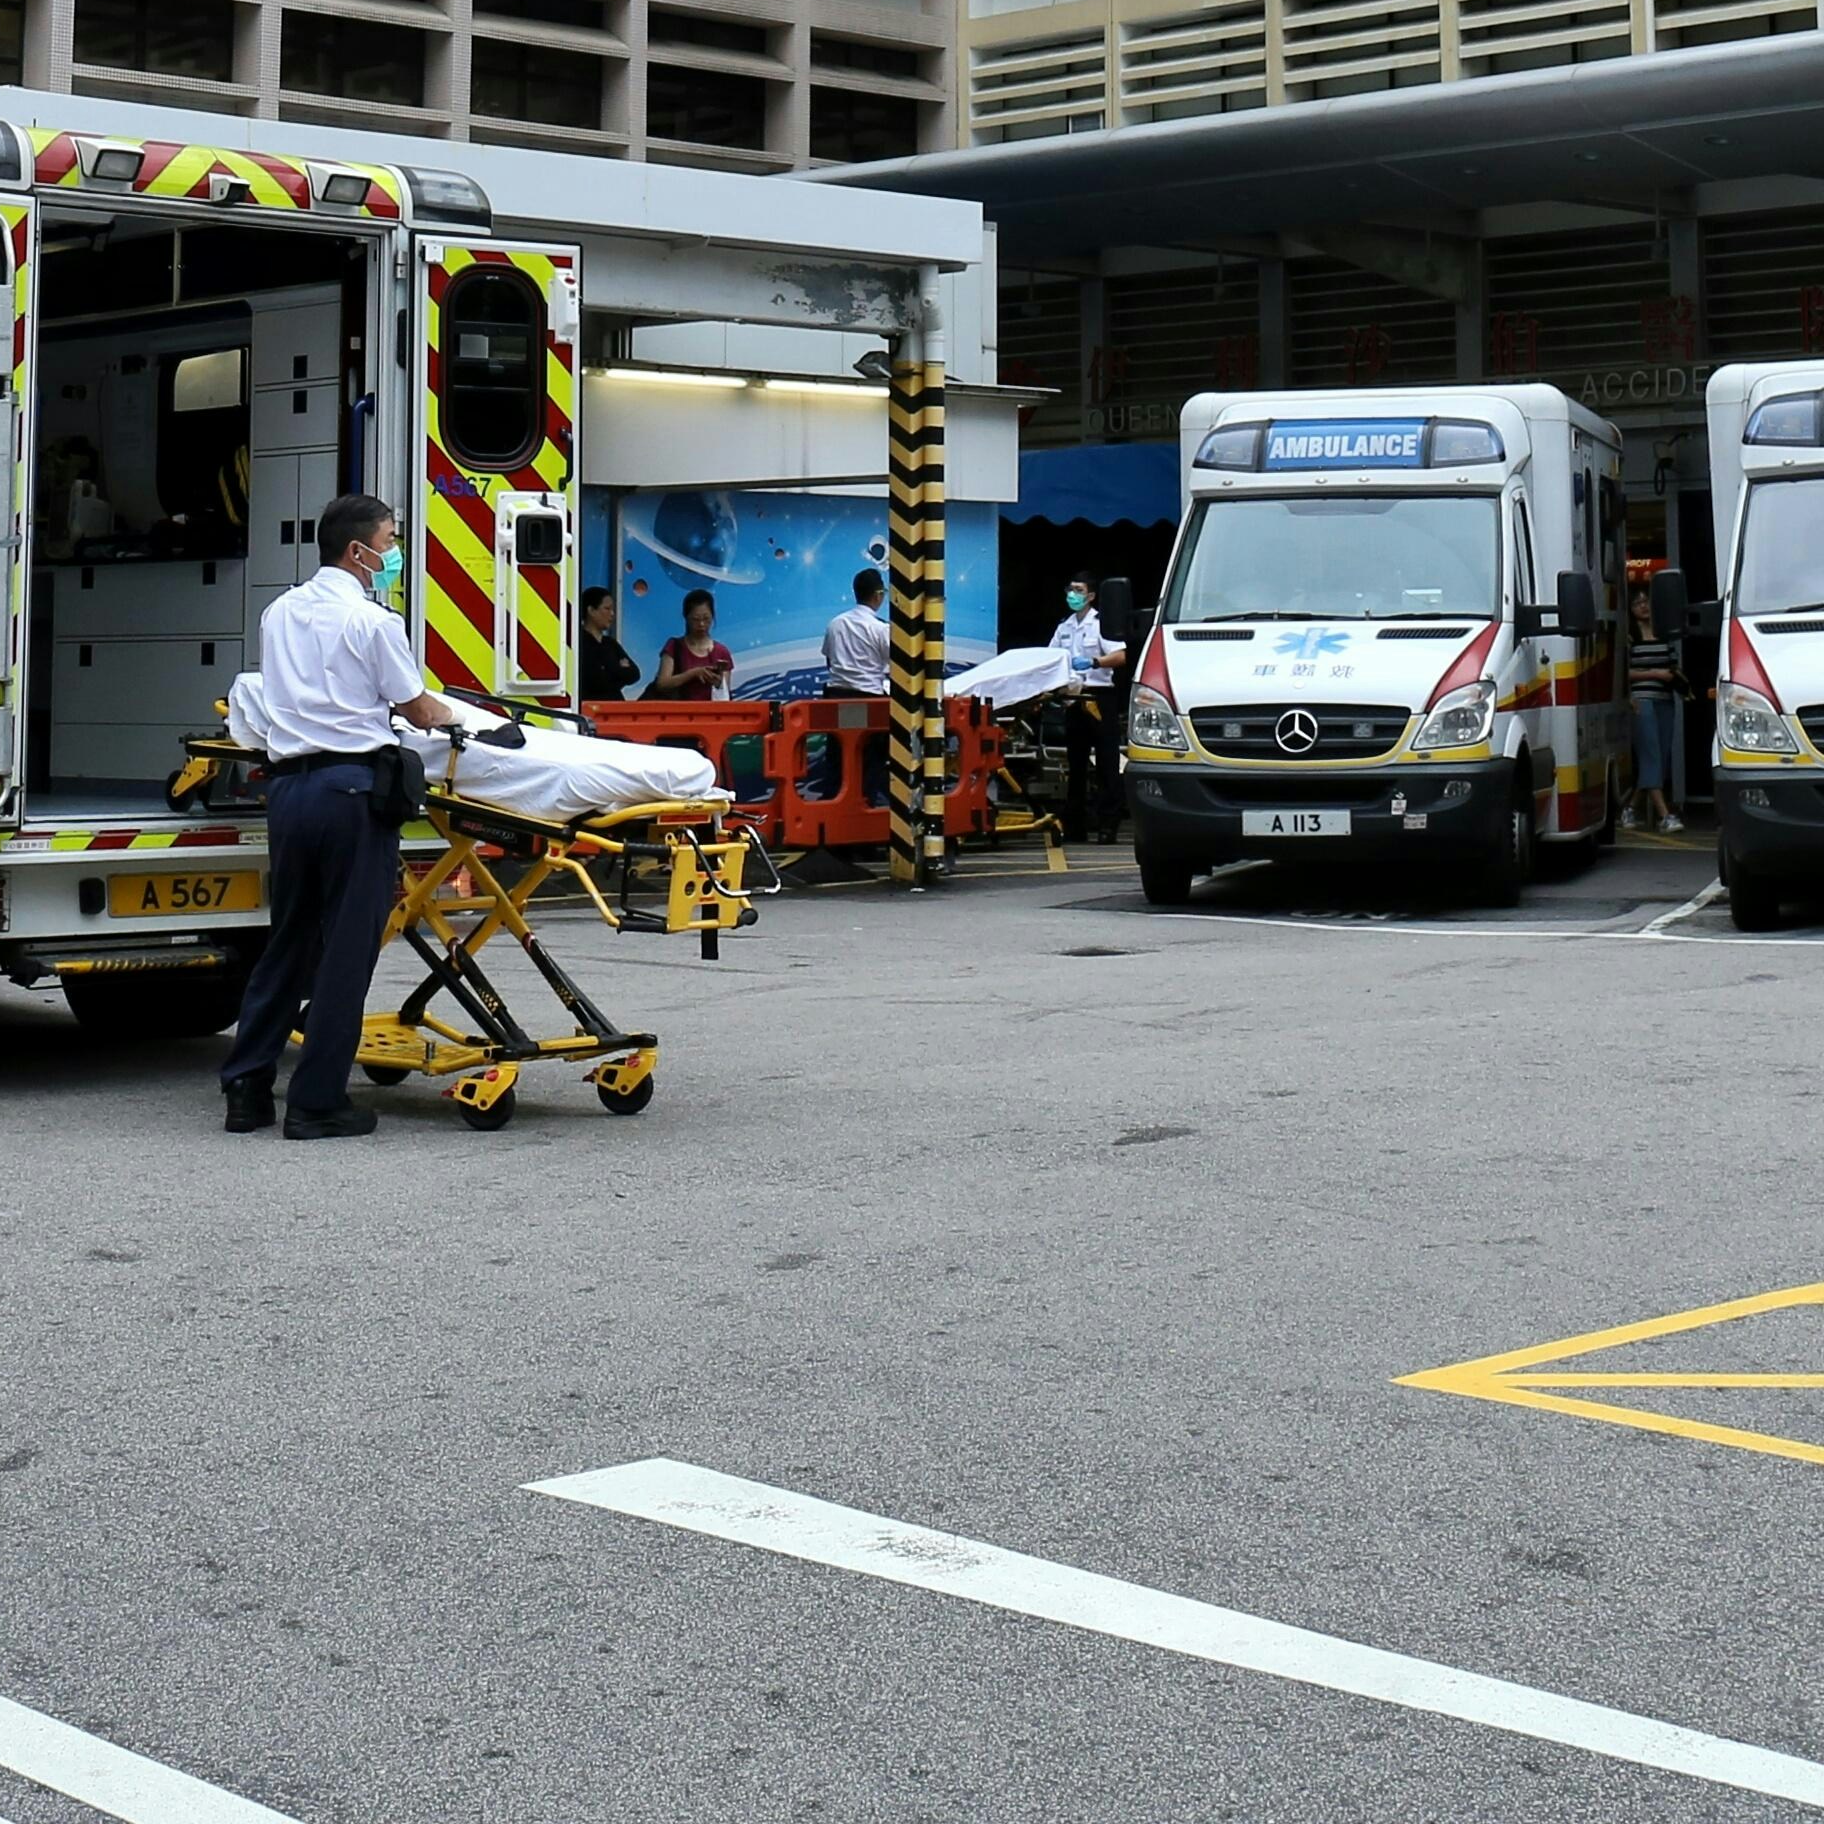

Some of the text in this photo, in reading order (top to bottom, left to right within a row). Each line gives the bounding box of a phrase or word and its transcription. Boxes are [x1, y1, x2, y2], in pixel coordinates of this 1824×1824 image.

[1579, 366, 1710, 404] ACCIDE
[1269, 434, 1418, 459] AMBULANCE
[430, 473, 492, 498] A567
[1271, 814, 1321, 833] A 113
[141, 877, 232, 910] A 567
